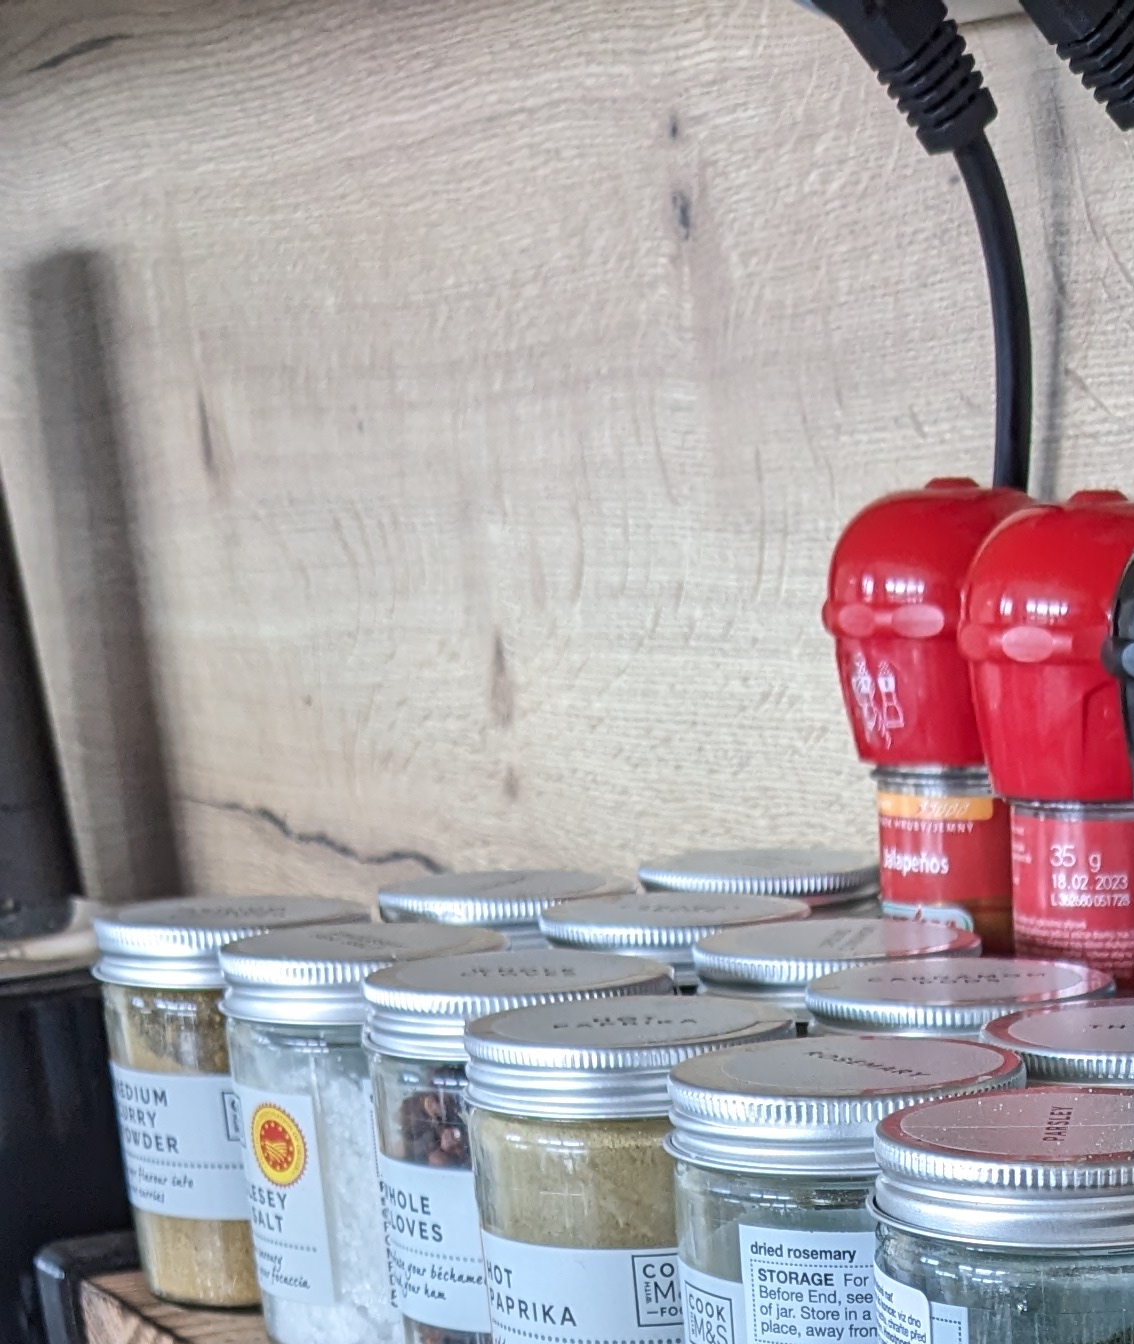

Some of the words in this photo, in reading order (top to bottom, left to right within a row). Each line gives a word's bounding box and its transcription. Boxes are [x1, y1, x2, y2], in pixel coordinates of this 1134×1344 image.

[1050, 845, 1076, 867] 35
[1088, 852, 1102, 872] g
[1052, 874, 1129, 891] 18.02.2023
[117, 1079, 168, 1107] EDIUM
[121, 1104, 157, 1129] URRY
[1042, 1105, 1074, 1142] PARSLEY
[124, 1127, 180, 1154] OWDER
[252, 1206, 284, 1233] SALT
[390, 1210, 443, 1243] LOVES
[750, 1241, 783, 1258] dried
[787, 1249, 857, 1263] rosemary
[486, 1259, 512, 1289] HOT
[642, 1263, 675, 1279] CO
[757, 1268, 835, 1287] STORAGE
[843, 1273, 869, 1287] For
[653, 1280, 681, 1304] M
[759, 1285, 804, 1303] Before
[808, 1289, 842, 1306] End,
[846, 1294, 874, 1305] see
[489, 1287, 578, 1327] PAPRIKA
[688, 1293, 727, 1323] COOK
[760, 1303, 773, 1316] of
[776, 1305, 796, 1321] jar.
[800, 1307, 840, 1321] Store
[844, 1308, 857, 1321] in
[862, 1310, 872, 1321] a
[761, 1320, 801, 1338] place,
[805, 1325, 843, 1341] away
